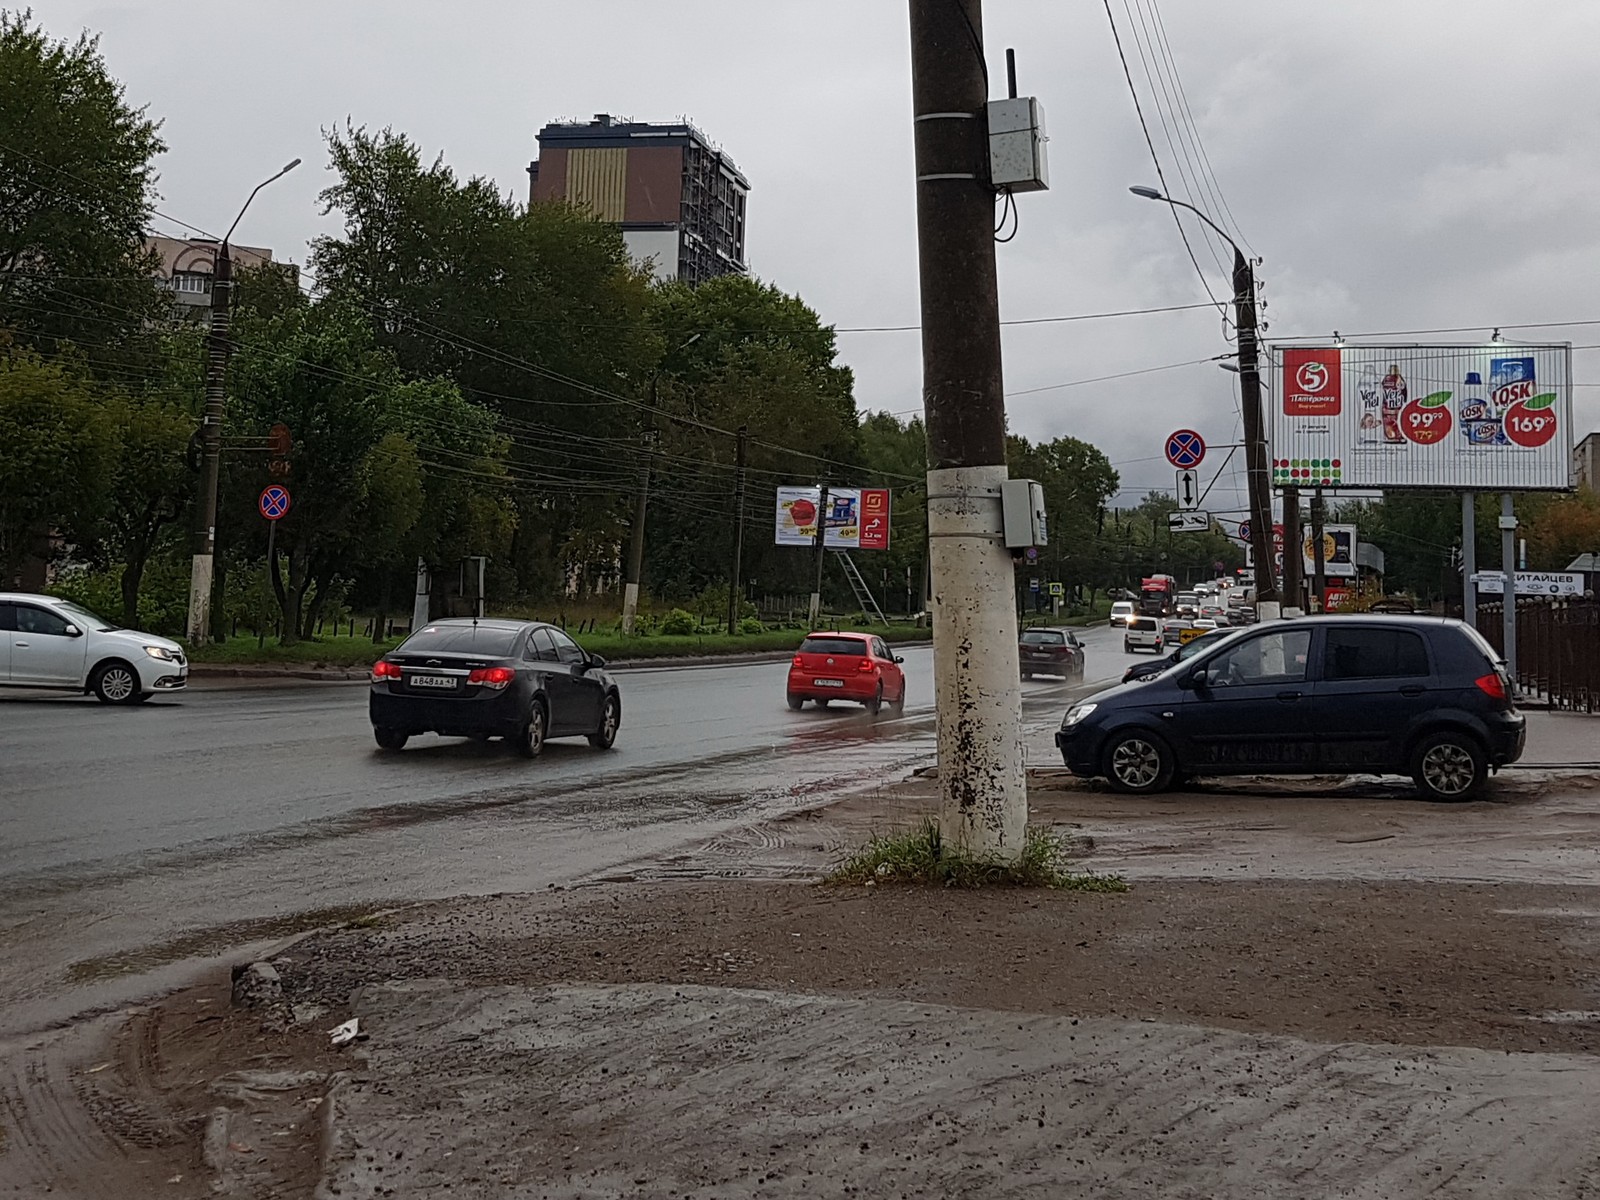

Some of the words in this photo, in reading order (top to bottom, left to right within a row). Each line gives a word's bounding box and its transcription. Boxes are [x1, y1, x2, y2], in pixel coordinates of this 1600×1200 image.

[1303, 370, 1321, 390] 5
[1360, 389, 1377, 401] Ver
[1384, 389, 1401, 401] Ver
[1491, 381, 1532, 407] LOSK
[1365, 396, 1379, 409] nel
[1461, 405, 1482, 419] LOSK
[1477, 423, 1496, 435] LOSK
